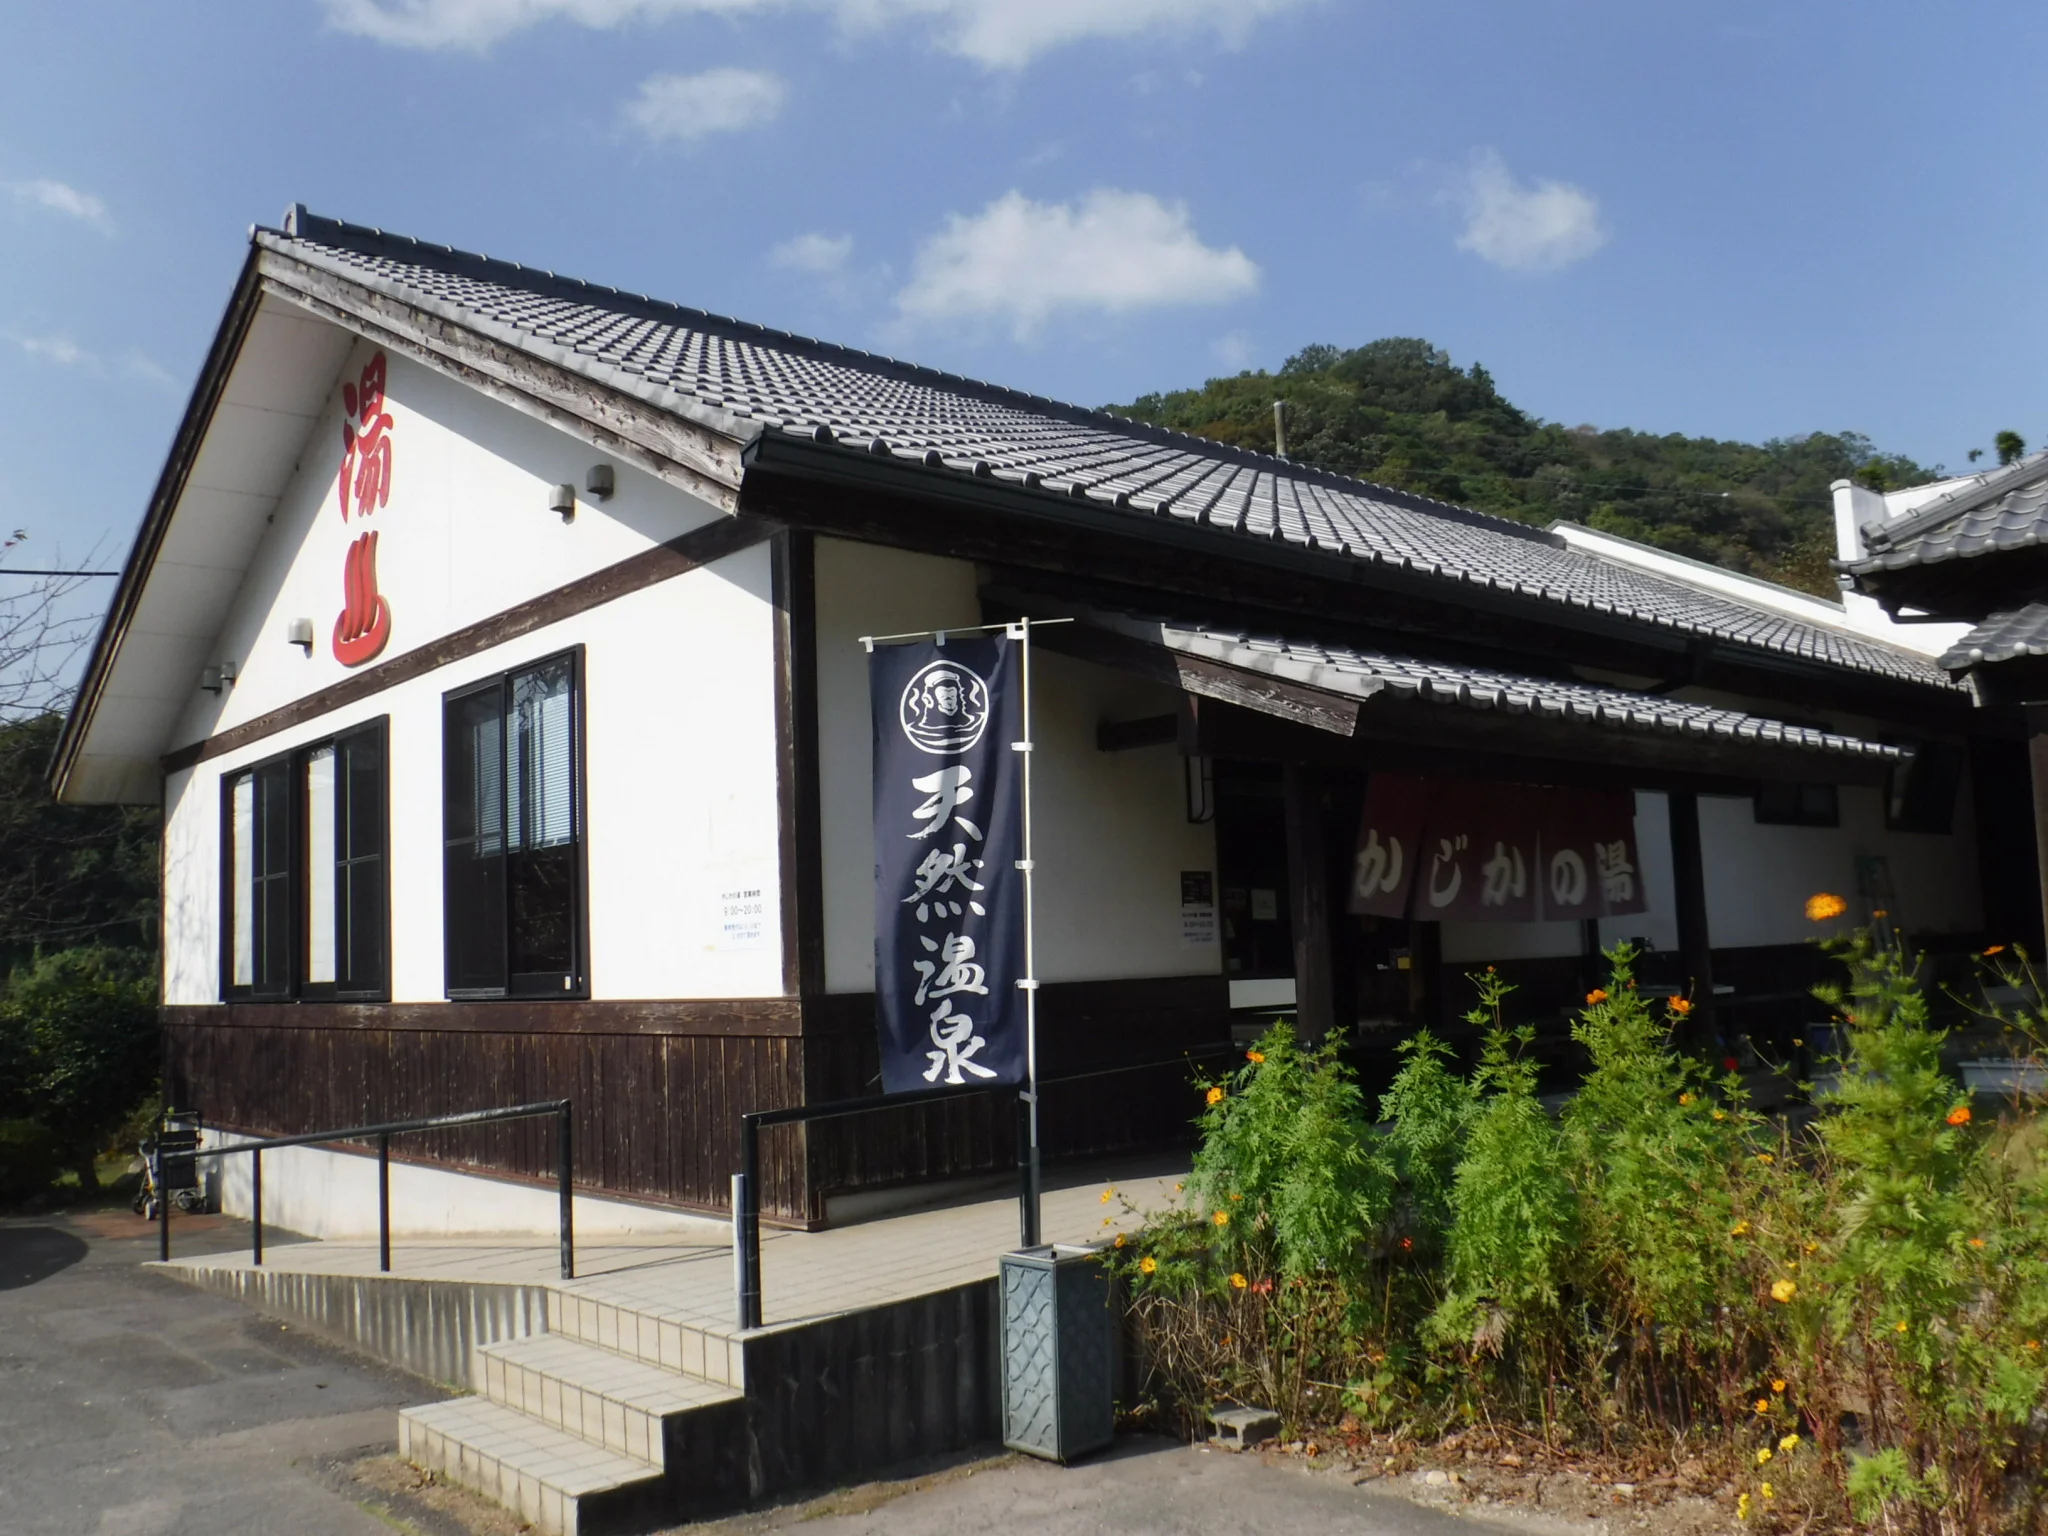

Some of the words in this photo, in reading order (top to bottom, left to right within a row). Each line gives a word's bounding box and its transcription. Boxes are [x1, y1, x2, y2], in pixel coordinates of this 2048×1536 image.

[338, 350, 394, 525] 湯
[901, 764, 998, 1085] 天然温泉
[1356, 828, 1634, 908] かじかの湯
